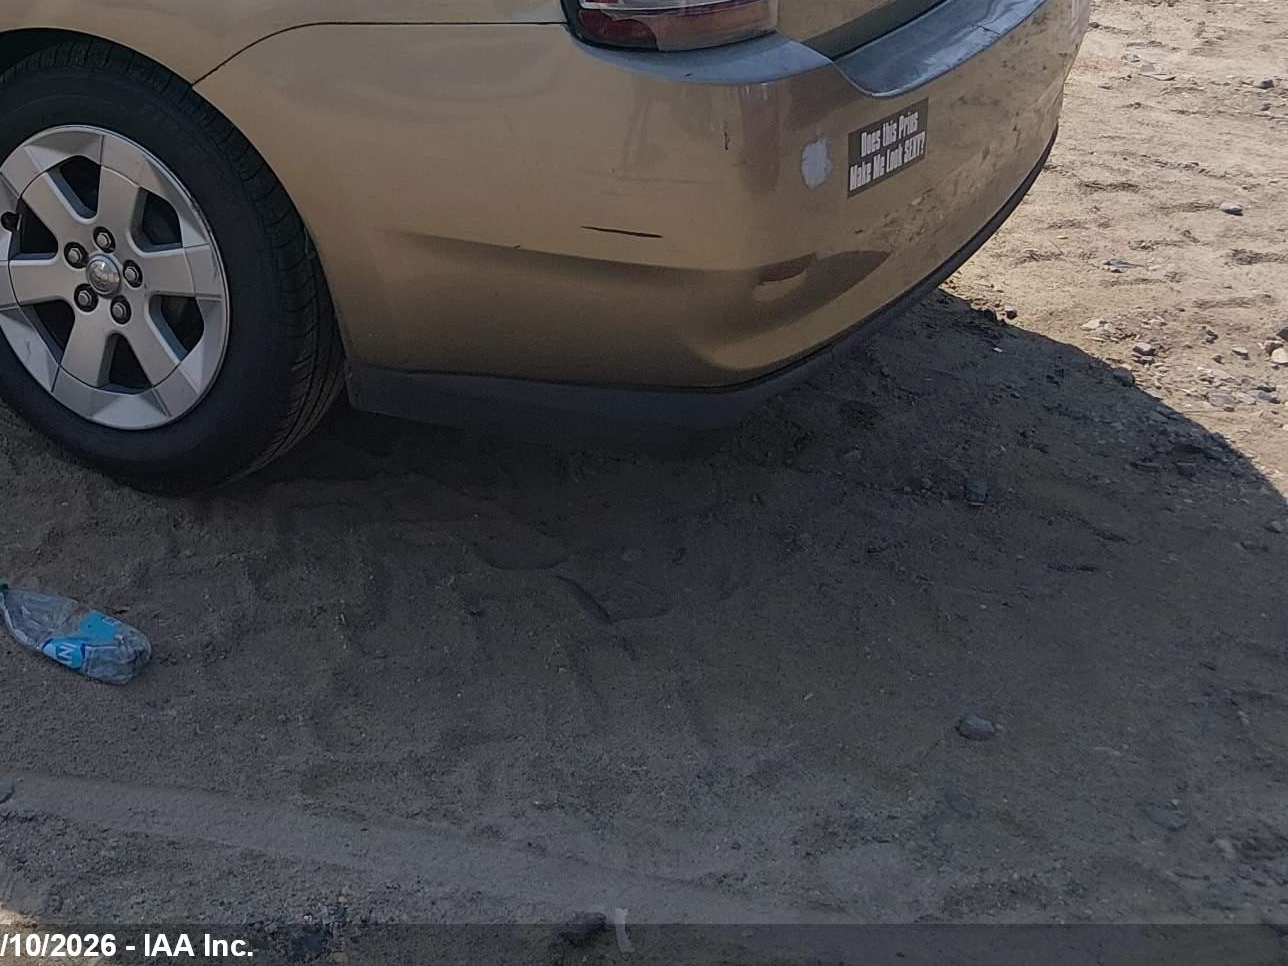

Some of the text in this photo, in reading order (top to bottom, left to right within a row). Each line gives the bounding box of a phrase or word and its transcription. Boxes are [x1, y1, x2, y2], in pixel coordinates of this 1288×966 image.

[861, 111, 919, 157] Does this Prius
[849, 161, 872, 191] Make
[873, 154, 885, 180] Me
[886, 143, 903, 173] Look
